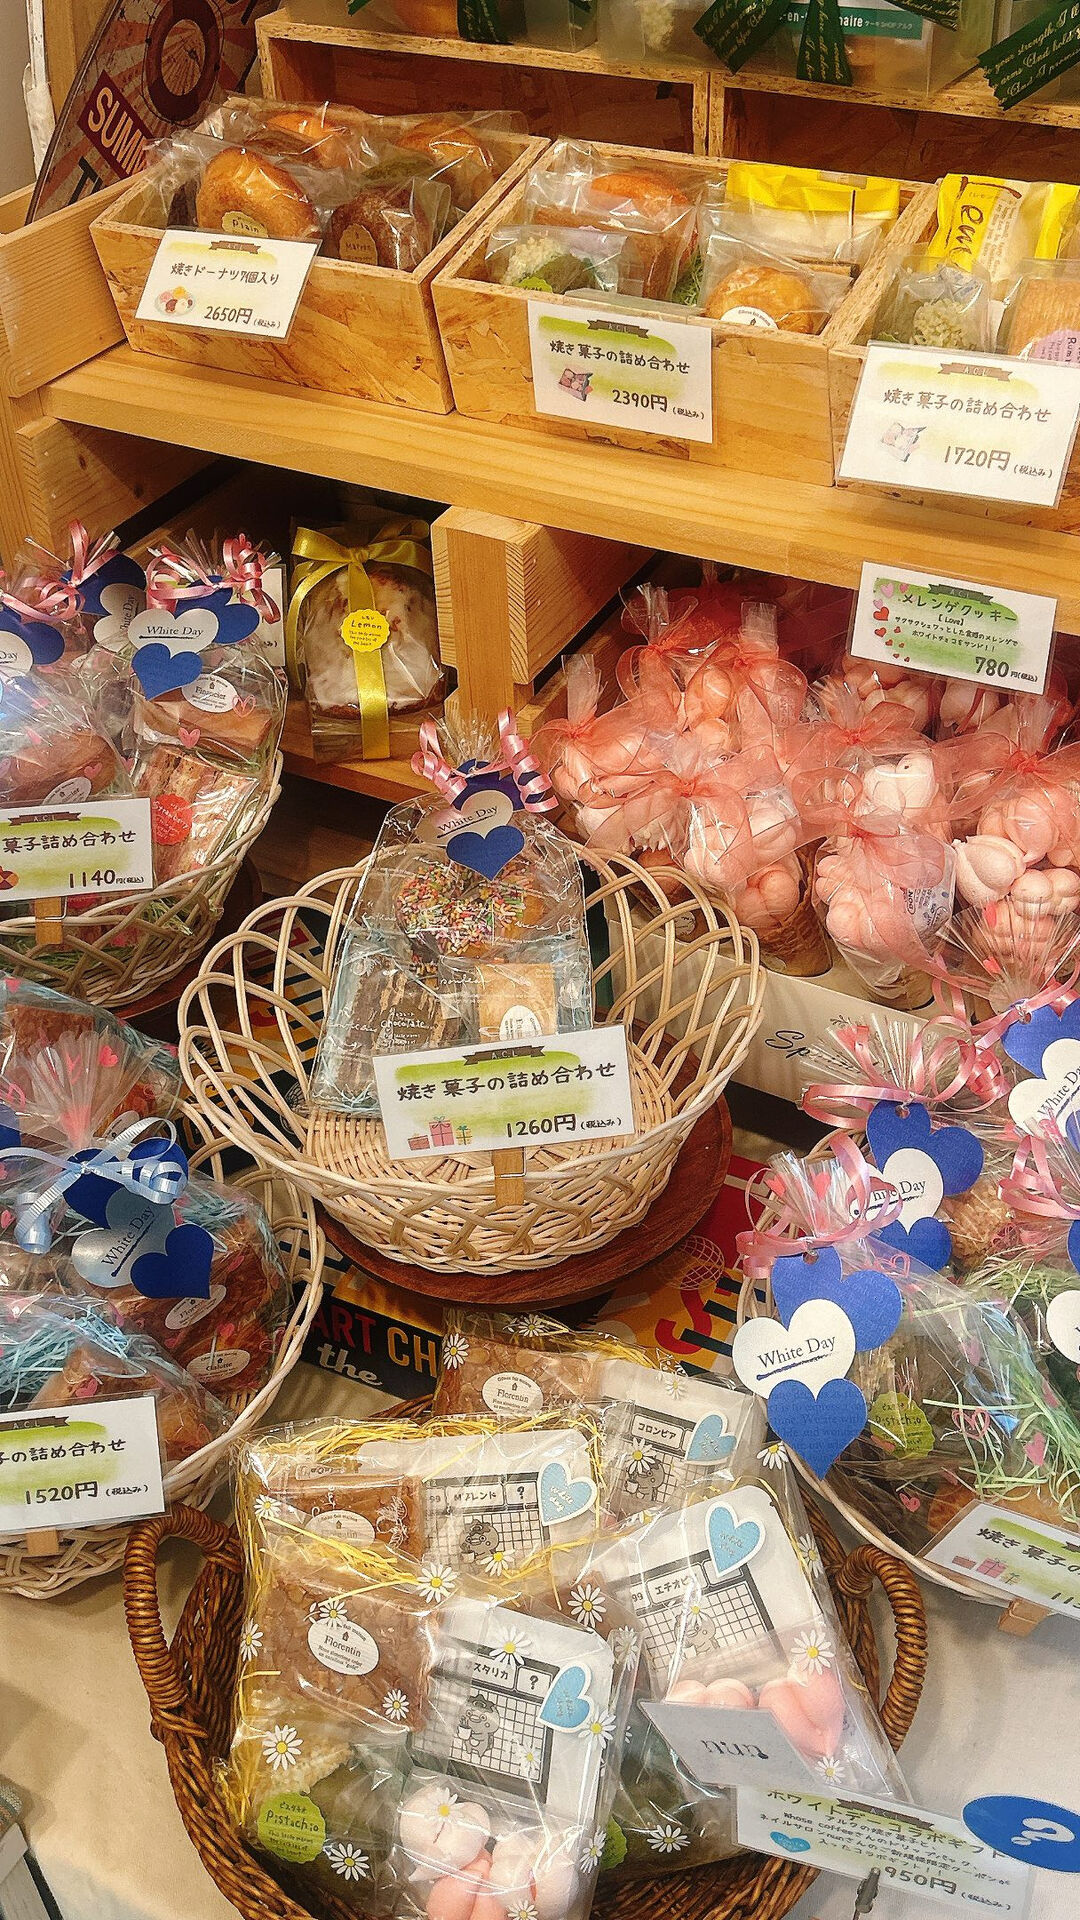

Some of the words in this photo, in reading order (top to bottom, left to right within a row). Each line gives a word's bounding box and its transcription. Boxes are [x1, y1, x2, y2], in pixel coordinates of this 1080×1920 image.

[170, 262, 280, 286] 焼きドーナツ7個入り
[203, 306, 253, 325] 2650円
[550, 340, 691, 374] 焼き菓子の詰め合わせ
[612, 388, 669, 412] 2390円
[883, 388, 1052, 423] 焼き菓子の詰め合わせ
[944, 445, 1012, 472] 1720円
[1013, 464, 1054, 479] (税込み)
[901, 593, 1017, 622] メレンゲクッキー
[146, 625, 178, 636] White
[182, 626, 204, 638] Day
[351, 619, 382, 630] Lemon
[437, 815, 474, 832] White
[475, 805, 499, 818] Day
[2, 830, 137, 854] 菓子詰め合わせ
[397, 1062, 617, 1101] 焼き菓子の詰め合わせ
[507, 1113, 577, 1138] 1260円
[580, 1117, 622, 1131] (税込み)
[899, 1180, 926, 1195] Day
[101, 1231, 135, 1266] White
[129, 1206, 156, 1231] Day
[757, 1345, 804, 1368] White
[805, 1335, 836, 1354] Day
[316, 1342, 383, 1386] the
[638, 1422, 677, 1440] コロンビア
[25, 1481, 98, 1505] 1520円
[105, 1484, 149, 1497] (税込み)
[324, 1635, 362, 1658] Florentin
[266, 1809, 319, 1832] Pistachio
[767, 1789, 1006, 1859] ホワイトデーコラボギフト
